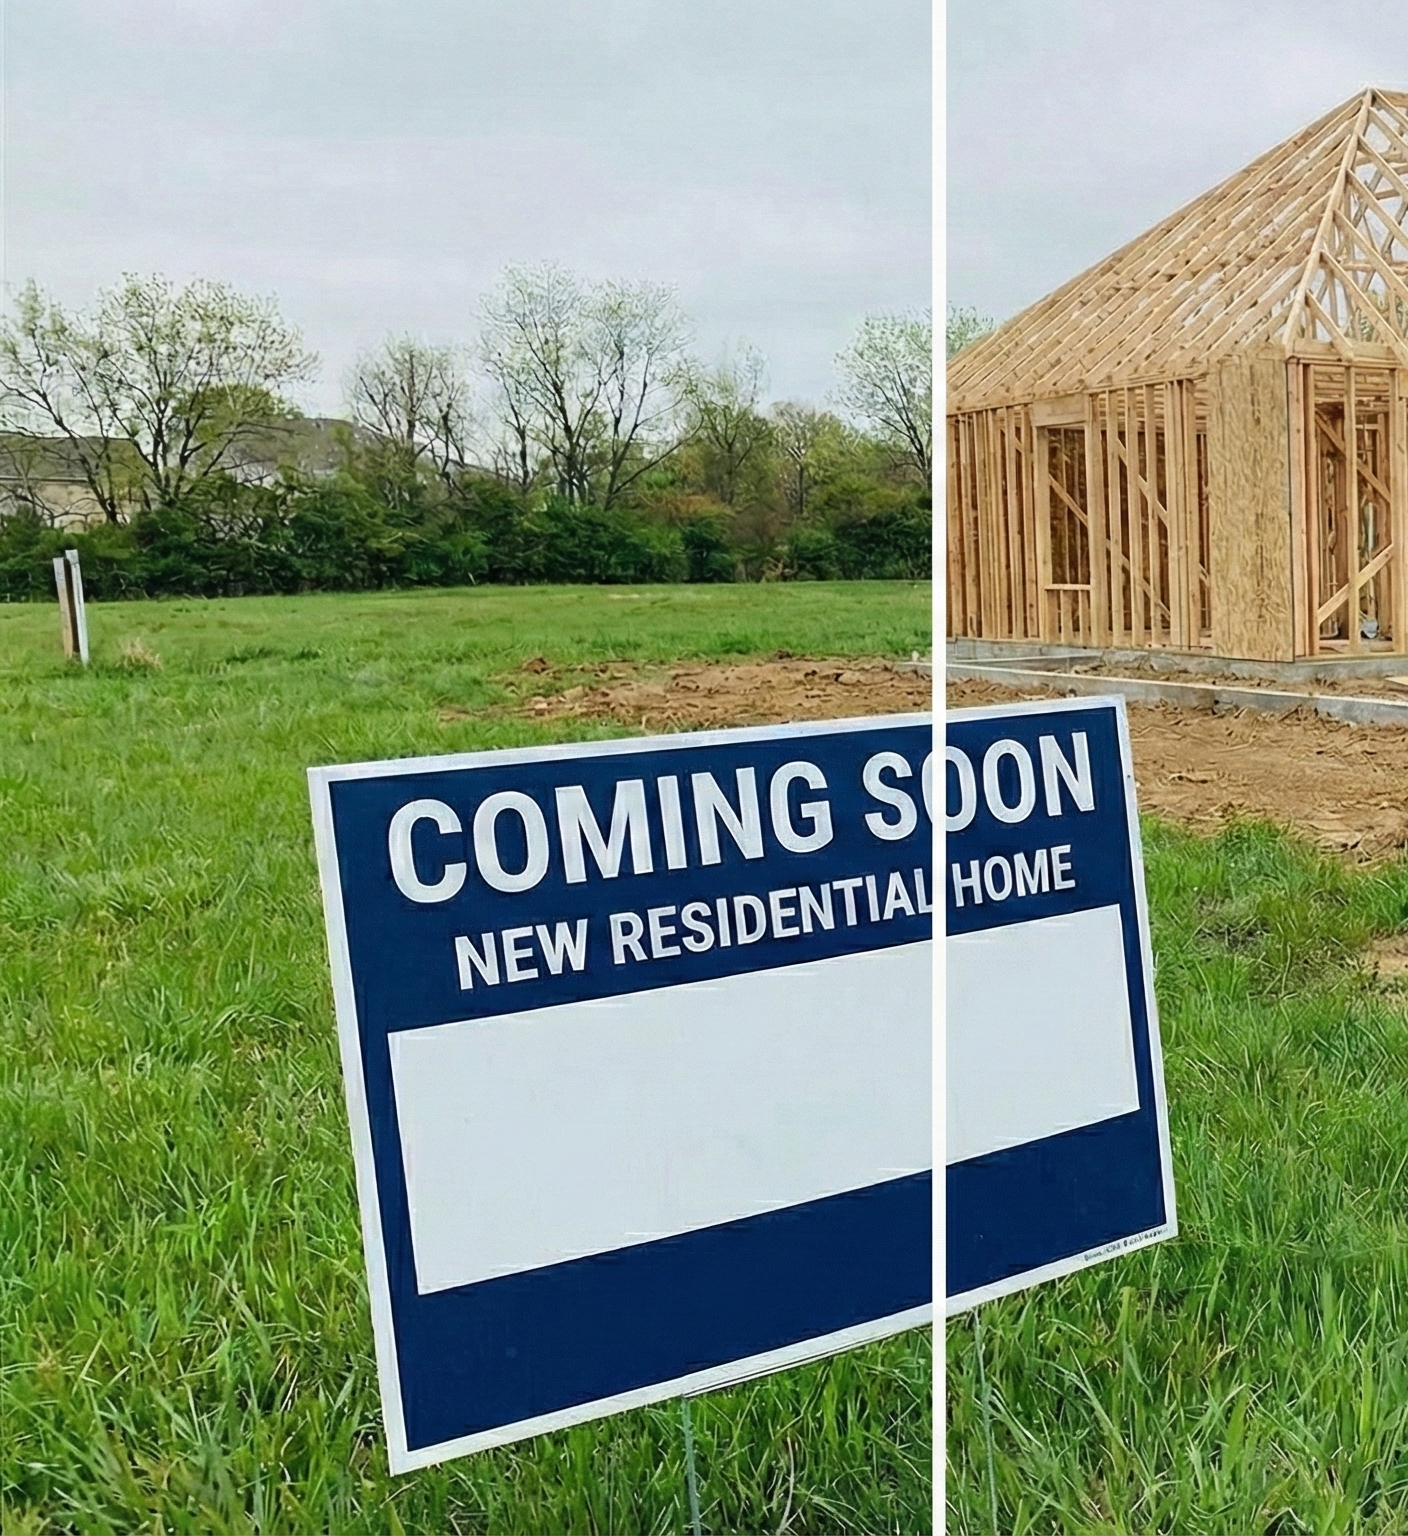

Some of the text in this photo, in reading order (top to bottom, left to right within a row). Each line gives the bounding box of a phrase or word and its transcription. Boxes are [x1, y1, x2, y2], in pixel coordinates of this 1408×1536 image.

[388, 731, 1096, 904] COMING SOON
[454, 844, 1076, 991] NEW RESIDENTIAL HOME
